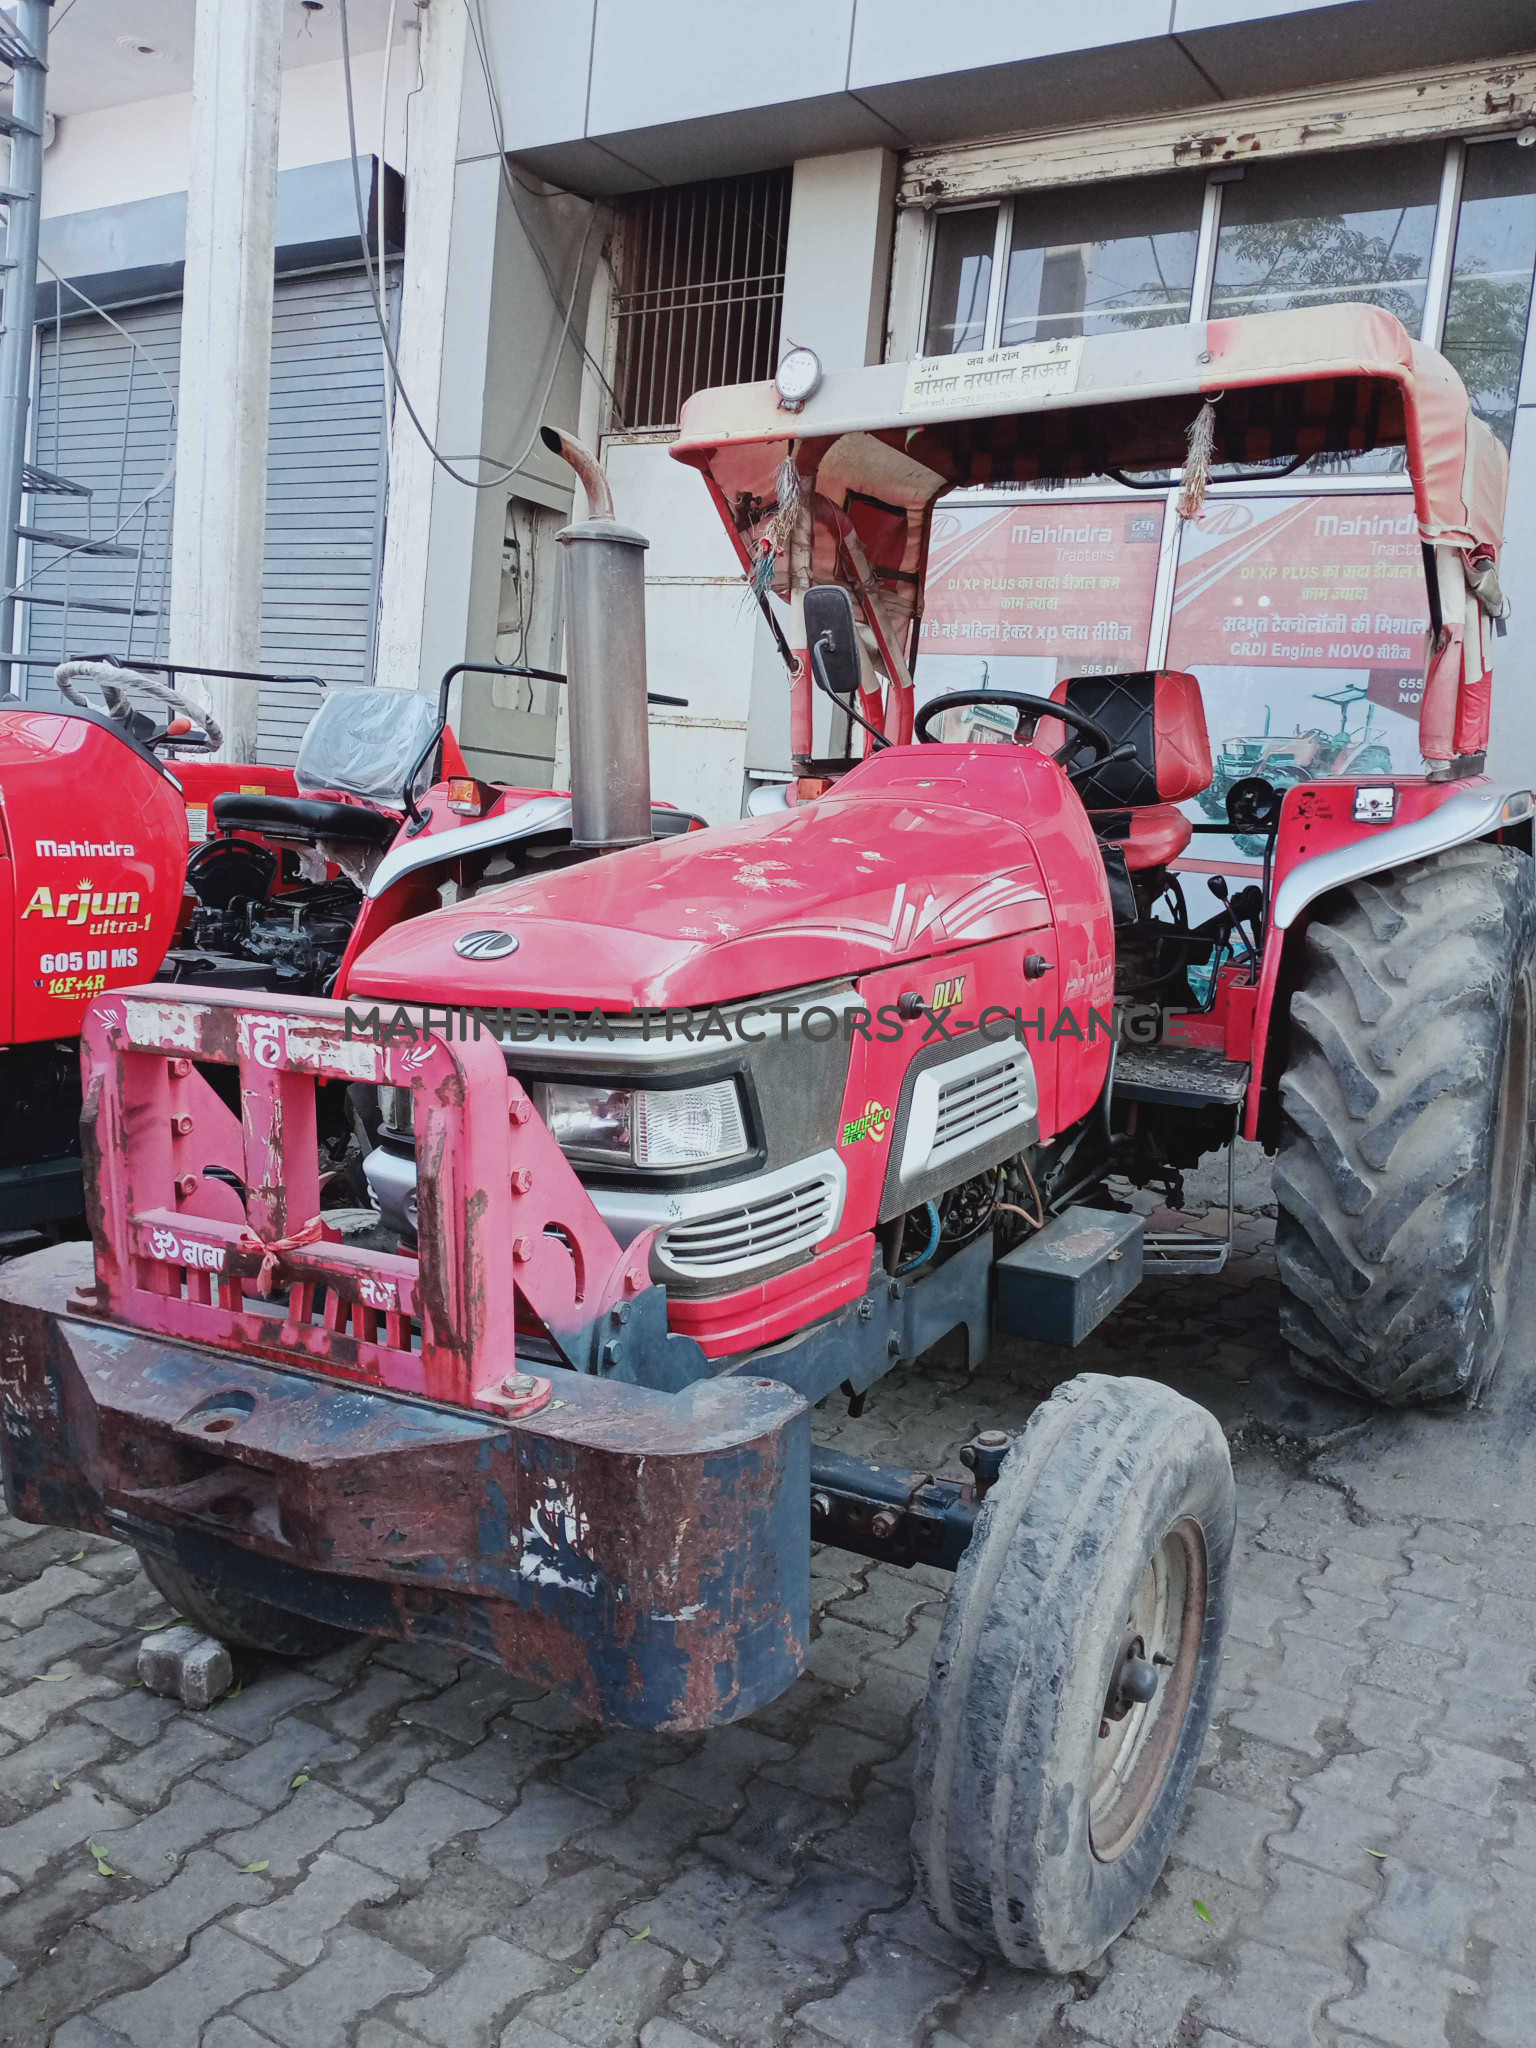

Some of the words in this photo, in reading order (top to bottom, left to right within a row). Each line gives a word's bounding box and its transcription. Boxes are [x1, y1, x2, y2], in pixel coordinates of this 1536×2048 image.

[967, 357, 984, 366] जय
[914, 374, 961, 396] बांसल
[964, 368, 1017, 390] तरपाल
[1021, 360, 1071, 385] हाऊस
[1011, 524, 1112, 544] Mahindra
[1056, 547, 1114, 562] Tractors
[1240, 567, 1255, 580] DI
[1258, 566, 1277, 579] XP
[1281, 566, 1319, 579] PLUS
[1321, 564, 1340, 578] का
[948, 579, 961, 590] DI
[963, 579, 979, 590] XP
[983, 578, 1015, 590] PLUS
[1017, 576, 1034, 589] का
[1035, 576, 1060, 589] वादा
[1099, 576, 1121, 589] कम
[1000, 597, 1025, 610] काम
[1300, 587, 1329, 601] काम
[930, 618, 939, 638] है
[942, 619, 959, 641] नई
[1035, 626, 1058, 644] xp
[1061, 624, 1089, 640] प्लस
[1091, 621, 1133, 641] सीरीज
[1351, 613, 1371, 634] की
[1230, 642, 1267, 657] CRDI
[1271, 643, 1323, 661] Engine
[1327, 644, 1375, 659] NOVO
[1080, 665, 1102, 675] 585
[1399, 677, 1423, 689] 655
[1399, 692, 1423, 704] NO
[35, 840, 135, 857] Mahindra
[21, 878, 140, 926] Arjun
[89, 913, 152, 935] ultra-1
[40, 952, 83, 974] 605
[87, 950, 107, 970] DI
[111, 948, 138, 968] MS
[48, 974, 106, 995] 16F+4R
[932, 976, 966, 1012] DLX
[181, 1238, 227, 1271] बाबा
